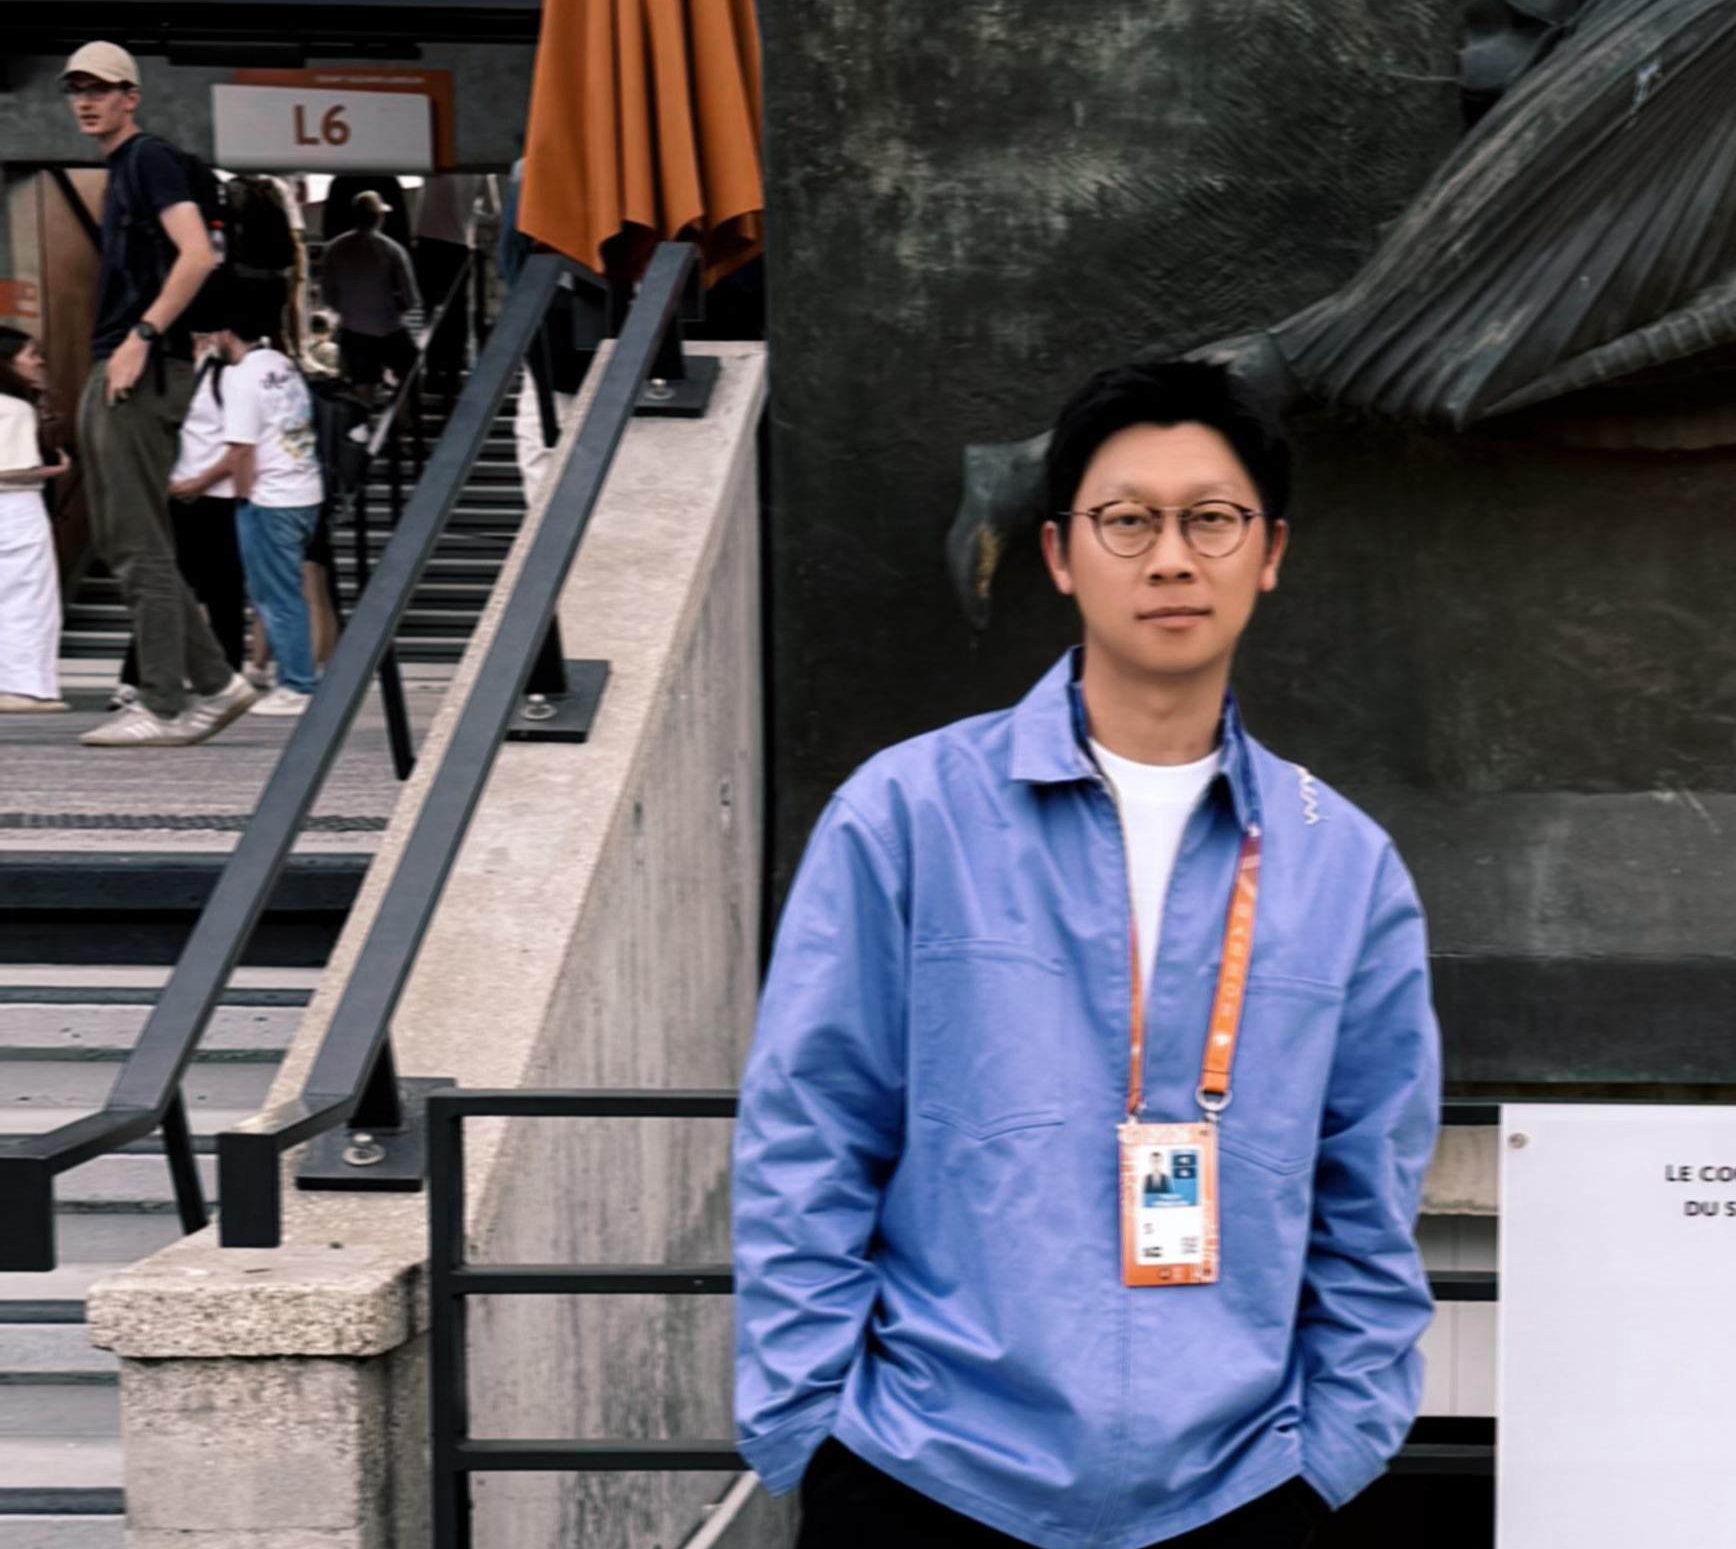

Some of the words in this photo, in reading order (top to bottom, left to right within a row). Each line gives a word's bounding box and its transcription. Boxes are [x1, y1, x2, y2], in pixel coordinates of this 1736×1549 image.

[293, 103, 353, 147] L6
[1664, 1164, 1694, 1183] LE
[1683, 1200, 1719, 1218] DU
